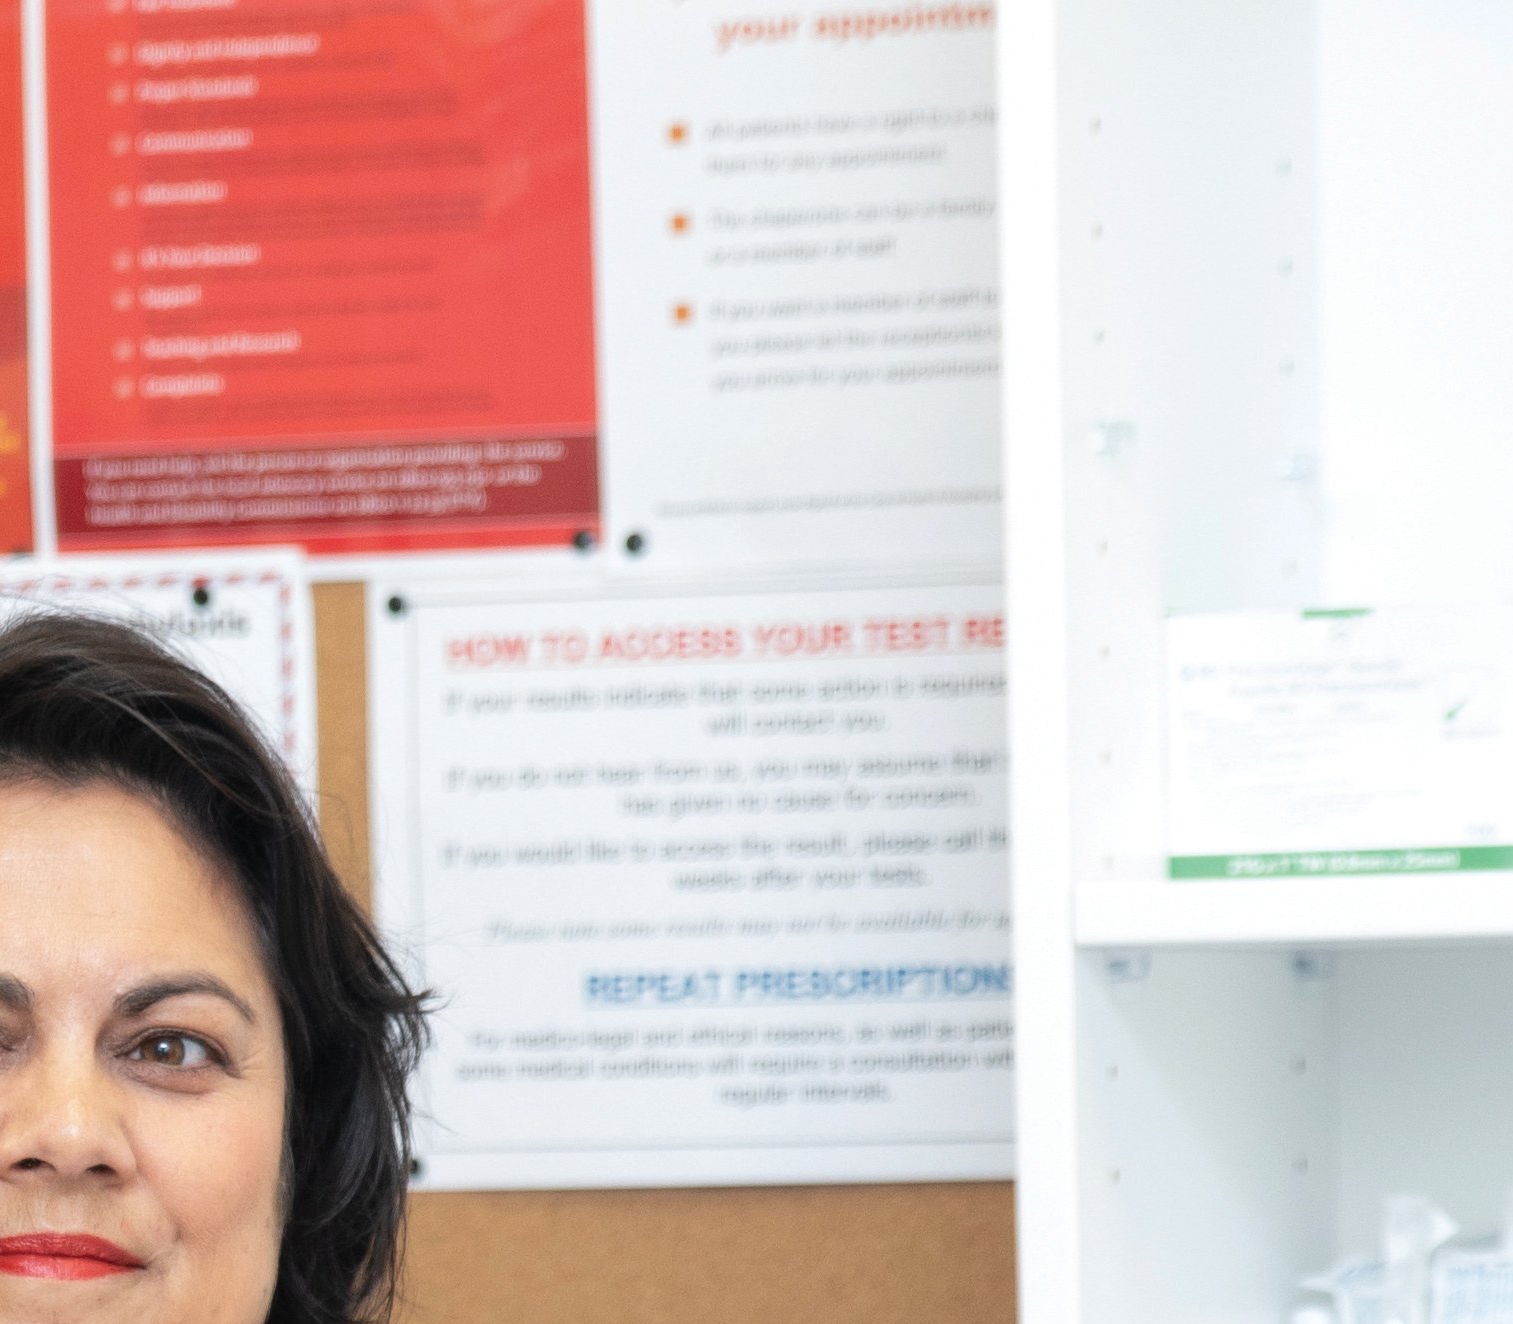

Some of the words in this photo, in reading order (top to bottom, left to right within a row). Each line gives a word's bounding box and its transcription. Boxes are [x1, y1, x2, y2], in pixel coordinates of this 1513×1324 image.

[713, 15, 798, 52] your
[444, 632, 532, 667] HOW
[539, 628, 591, 664] TO
[594, 621, 744, 661] ACCESS
[751, 615, 853, 656] YOUR
[862, 612, 952, 650] TEST
[581, 965, 725, 1004] REPEAT
[730, 958, 1017, 1001] PRESCRIPTION
